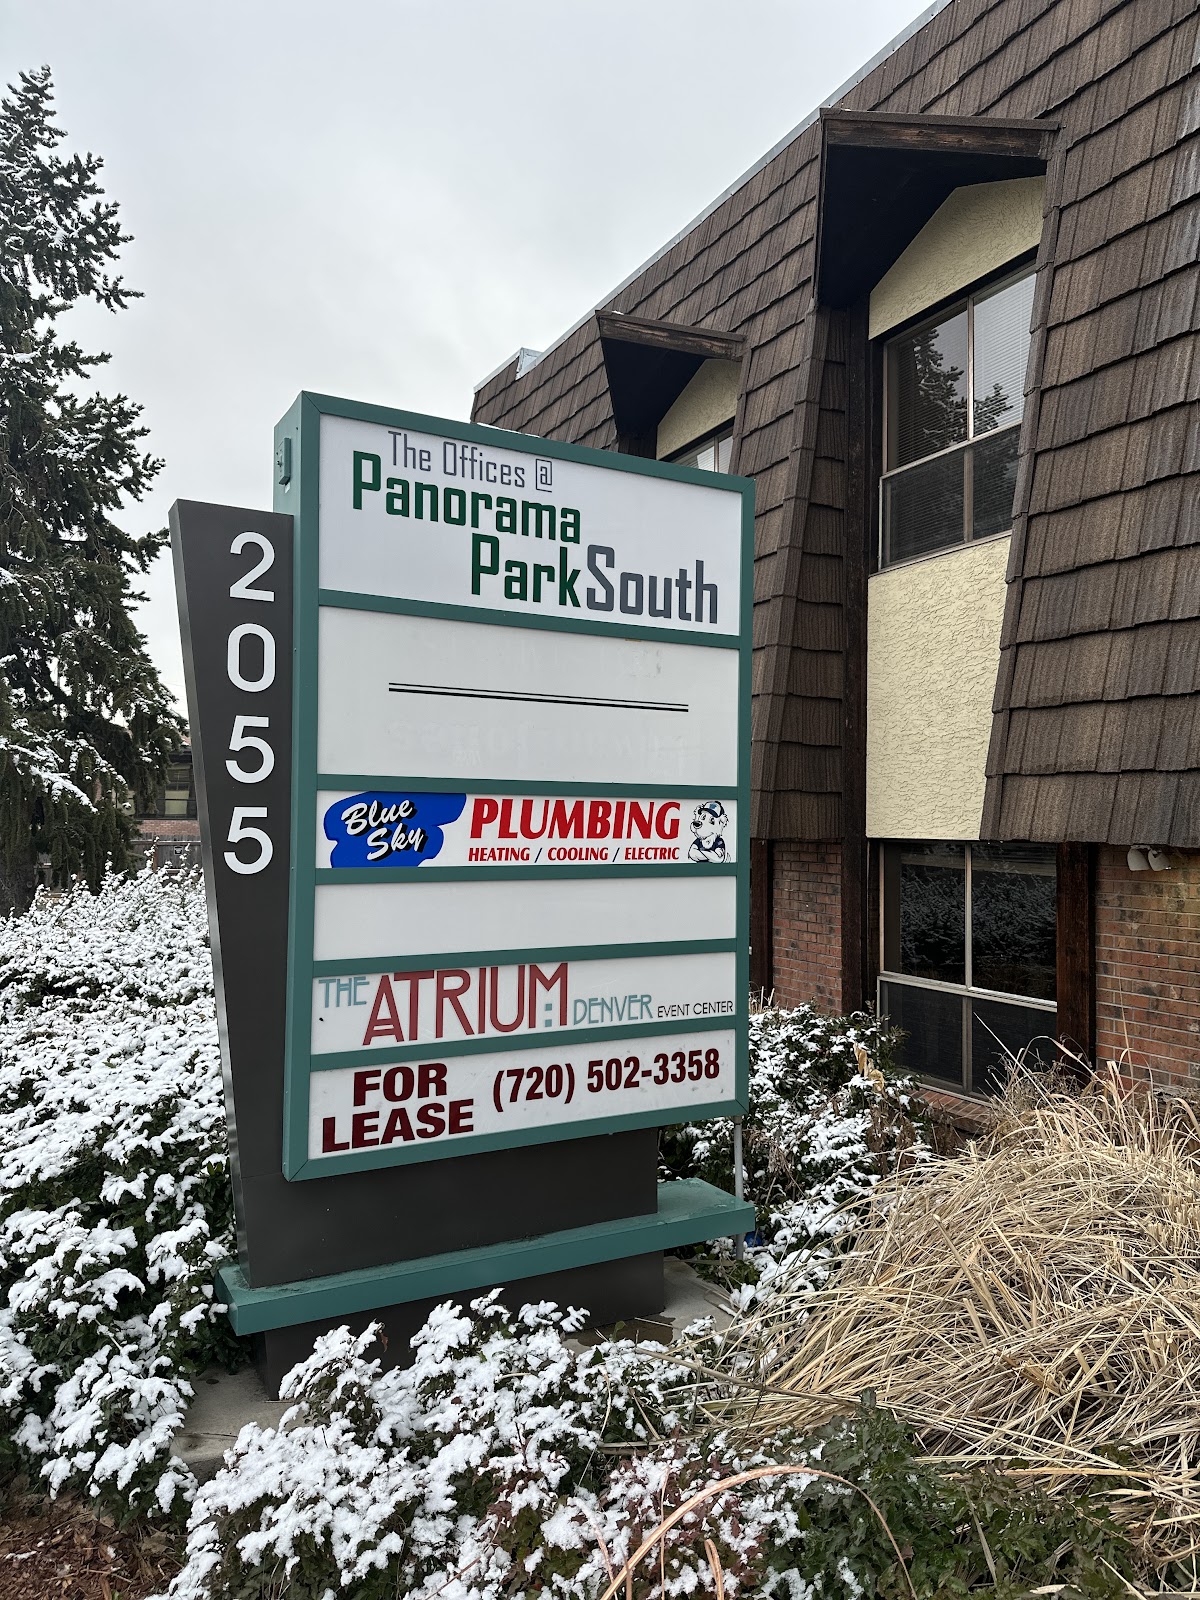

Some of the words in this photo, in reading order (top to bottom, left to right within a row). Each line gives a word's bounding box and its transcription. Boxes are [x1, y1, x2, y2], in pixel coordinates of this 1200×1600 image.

[388, 430, 431, 471] The
[443, 441, 525, 488] Offices
[535, 458, 552, 493] @
[353, 450, 580, 544] Panorama
[341, 799, 413, 835] Blue
[470, 798, 681, 840] PLUMBING
[367, 826, 424, 861] Sky
[468, 847, 530, 862] HEATING
[547, 847, 609, 861] COOLING
[624, 846, 680, 861] ELECTRIC
[318, 976, 370, 1009] THE
[573, 994, 653, 1026] DENVER
[657, 1004, 689, 1018] EVENT
[692, 1000, 734, 1015] CENTER
[353, 1062, 448, 1107] FOR
[493, 1063, 576, 1113] (720)
[587, 1048, 720, 1093] 502-3358
[322, 1099, 474, 1153] LEASE
